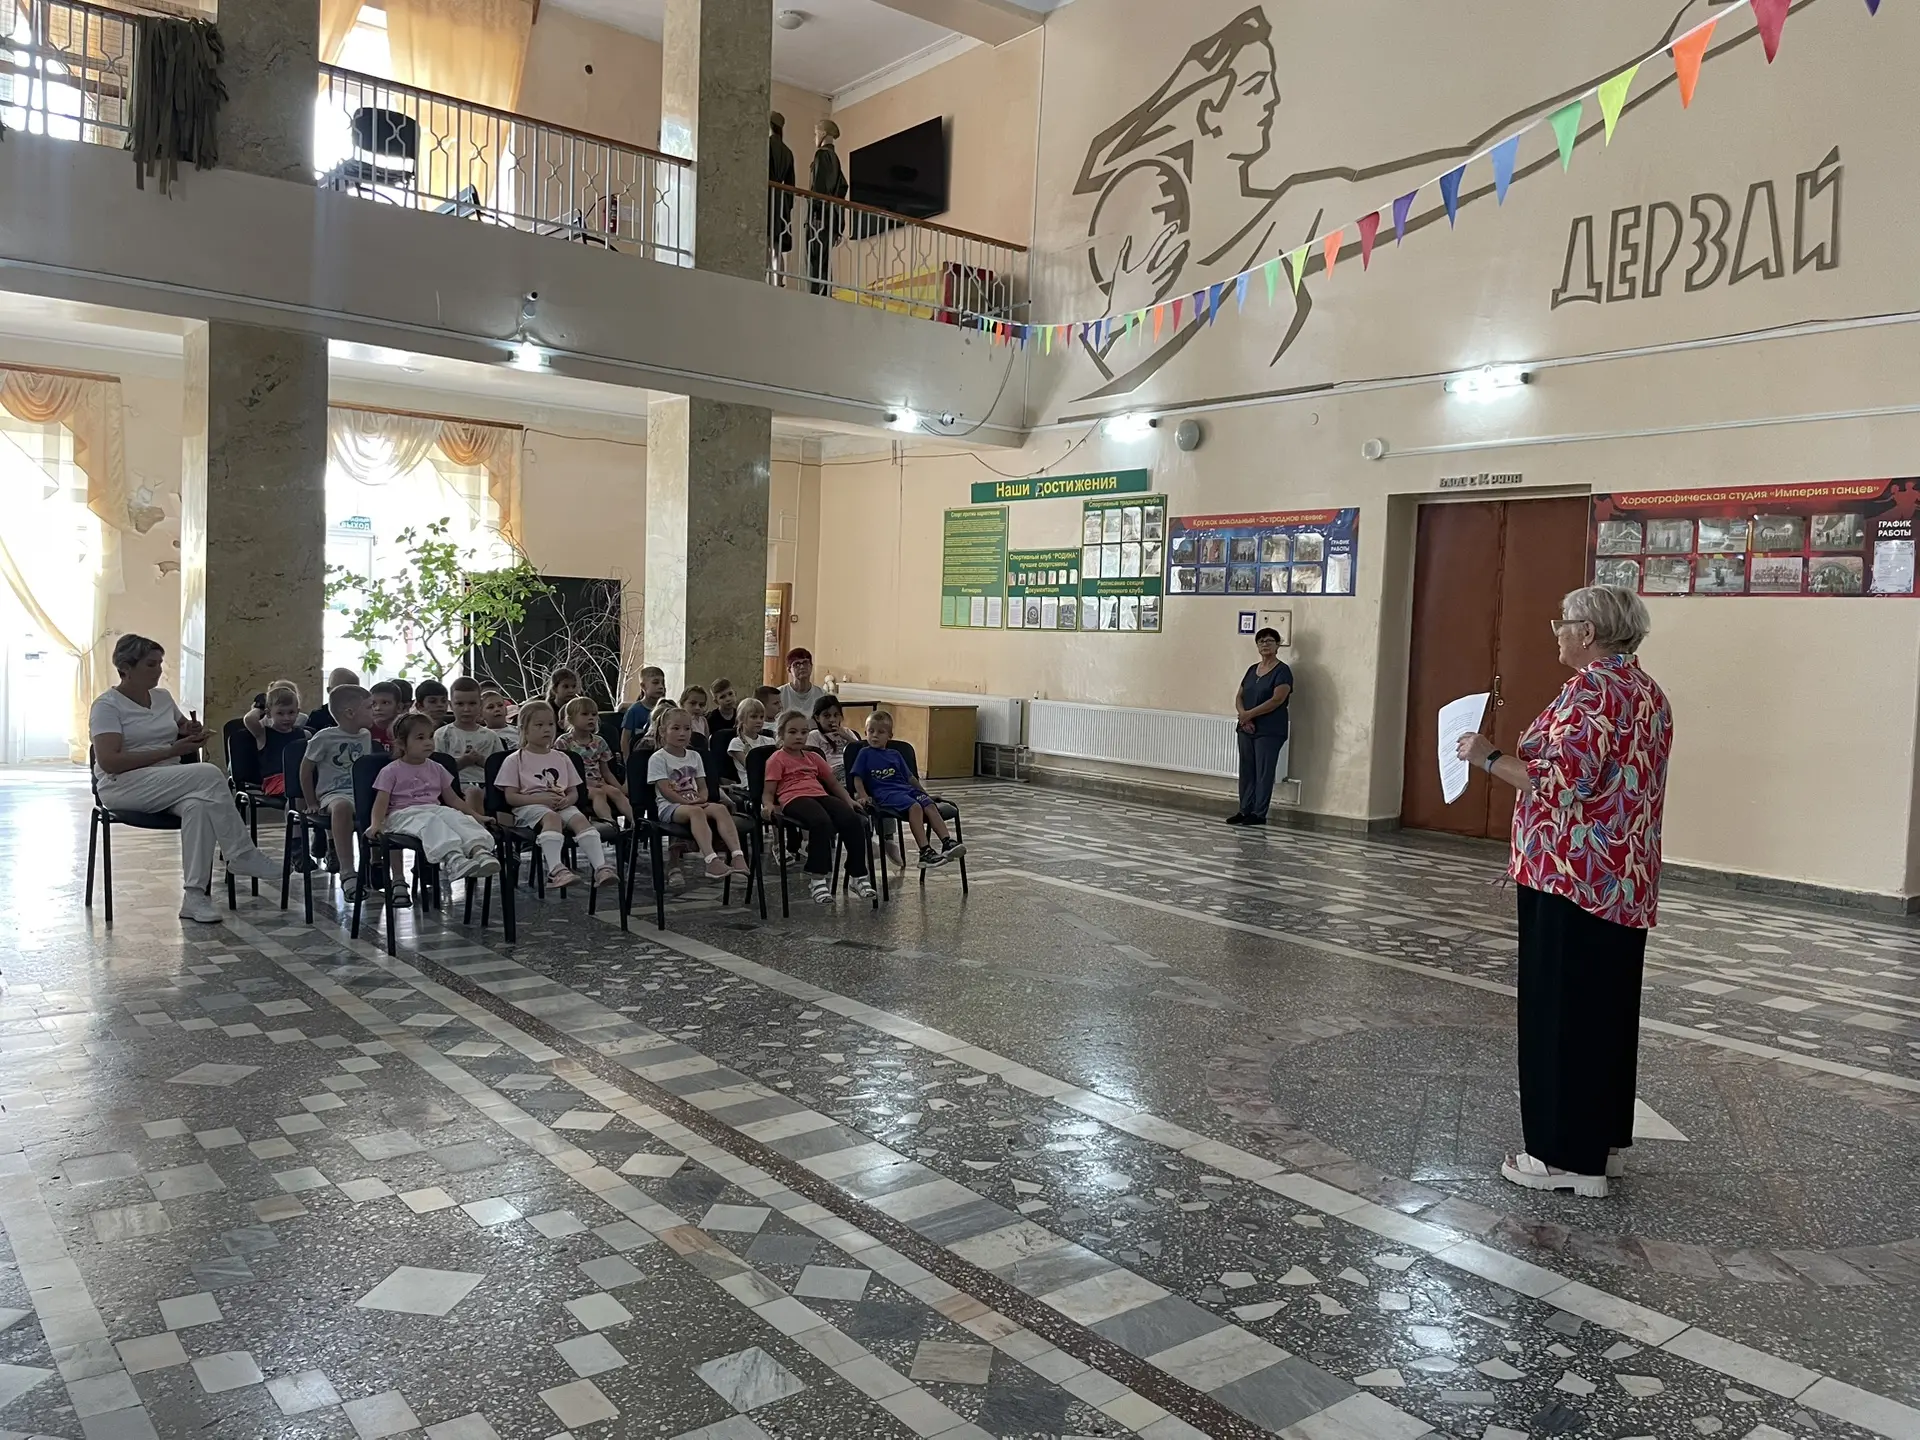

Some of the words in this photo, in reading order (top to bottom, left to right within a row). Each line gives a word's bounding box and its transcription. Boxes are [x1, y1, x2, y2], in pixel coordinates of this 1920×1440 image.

[1550, 145, 1844, 310] ДЕРЗАЙ
[996, 482, 1030, 498] Наши
[1621, 491, 1726, 506] Хореографическая
[1728, 490, 1767, 501] студия
[1770, 487, 1829, 499] «Империя
[1832, 484, 1880, 496] танцев»
[1193, 518, 1217, 528] Кружок
[1878, 520, 1911, 528] ГРАФИК
[1877, 529, 1911, 537] РАБОТЫ
[1040, 551, 1051, 561] клуб
